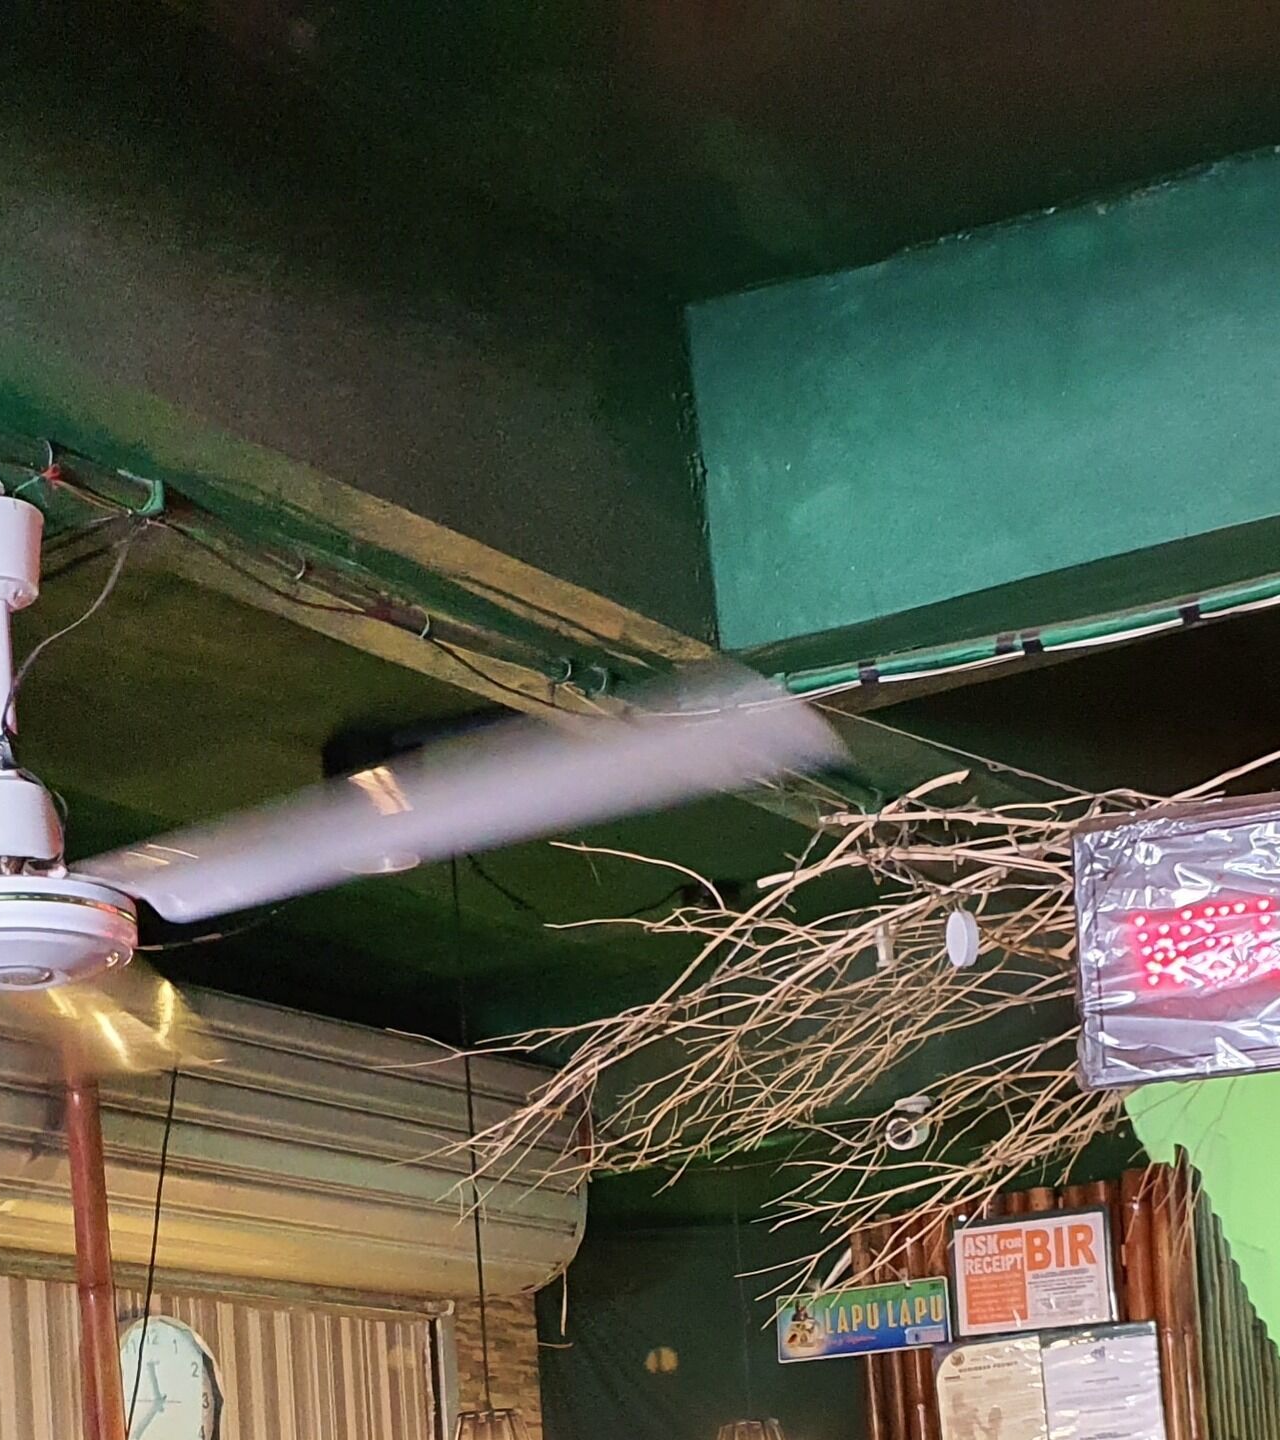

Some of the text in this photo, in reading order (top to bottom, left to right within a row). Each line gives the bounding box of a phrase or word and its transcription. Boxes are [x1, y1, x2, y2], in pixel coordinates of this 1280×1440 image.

[965, 1234, 1023, 1257] ASK FOR
[1025, 1224, 1096, 1271] BIR
[965, 1253, 1024, 1276] RECEIPT
[824, 1302, 880, 1334] LAPU
[886, 1294, 944, 1328] LAPU
[172, 1338, 178, 1354] 1
[191, 1361, 200, 1378] 2
[201, 1391, 210, 1409] 3
